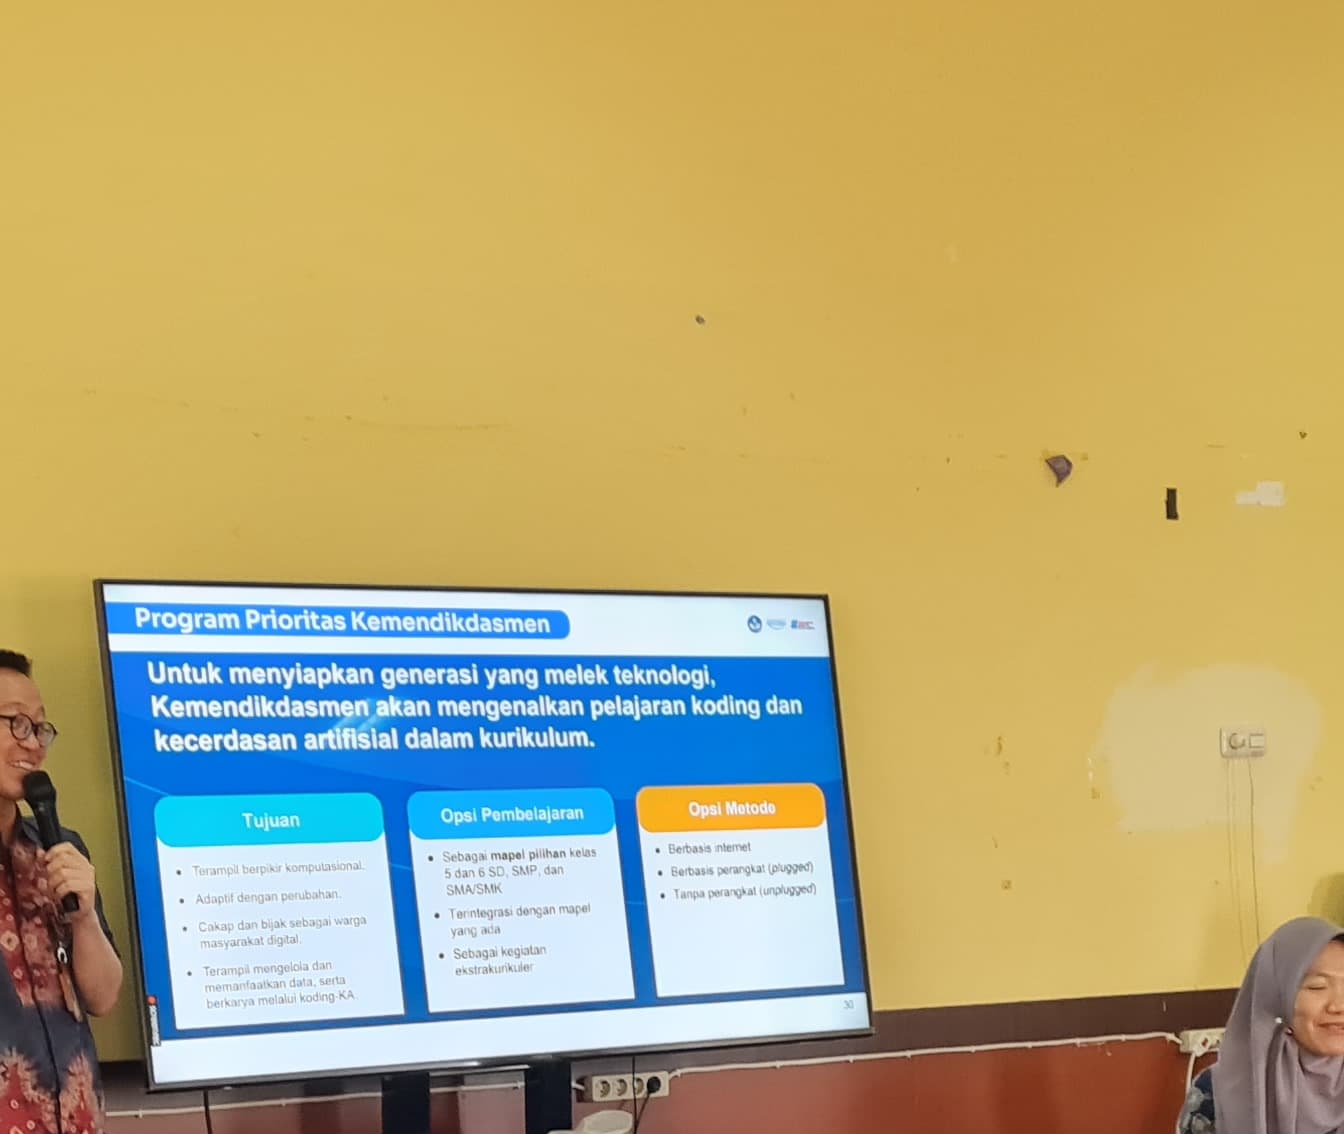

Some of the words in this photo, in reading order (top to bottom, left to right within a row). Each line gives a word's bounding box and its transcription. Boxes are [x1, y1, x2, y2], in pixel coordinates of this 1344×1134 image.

[135, 607, 239, 633] Program
[245, 609, 346, 631] Prioritas
[351, 610, 551, 633] Kemendikdasmen
[147, 661, 223, 685] Untuk
[229, 662, 374, 690] menyiapkan
[381, 663, 478, 690] generasi
[484, 666, 538, 690] yang
[545, 664, 608, 686] melek
[613, 664, 716, 690] teknologi,
[151, 695, 369, 718] Kemendikdasmen
[376, 695, 430, 717] akan
[437, 695, 584, 721] mengenalkan
[590, 695, 686, 721] pelajaran
[691, 695, 761, 719] koding
[766, 694, 803, 715] dan
[155, 728, 297, 752] kecerdasan
[304, 727, 399, 751] artifisial
[405, 726, 474, 750] dalam
[479, 727, 595, 748] kurikulum.
[440, 807, 477, 826] Opsi
[481, 805, 585, 824] Pembelajaran
[688, 801, 722, 819] Opsi
[725, 800, 777, 816] Metode
[241, 812, 301, 832] Tujuan
[442, 850, 489, 864] Sebagai
[490, 849, 526, 863] mapel
[528, 848, 567, 862] pilihan
[569, 847, 597, 859] kelas
[668, 843, 712, 855] Berbasis
[715, 842, 752, 853] internet
[192, 864, 240, 878] Terampil
[242, 863, 282, 877] berpikir
[444, 868, 452, 879] 5
[454, 867, 475, 879] dan
[478, 867, 486, 878] 6
[543, 863, 565, 876] dan
[671, 865, 714, 878] Berbasis
[717, 863, 765, 877] perangkat
[768, 861, 815, 876] (plugged)
[446, 882, 504, 897] SMA/SMK
[674, 888, 706, 901] Tanpa
[707, 885, 757, 900] perangkat
[759, 882, 817, 898] (unplugged)
[195, 892, 235, 906] Adaptif
[237, 891, 278, 906] dengan
[448, 906, 514, 921] Terintegrasi
[515, 904, 556, 919] dengan
[558, 902, 592, 917] mapel
[198, 920, 235, 934] Cakap
[237, 919, 258, 931] dan
[260, 916, 287, 931] bijak
[289, 915, 332, 930] sebagai
[333, 915, 367, 927] warga
[450, 926, 478, 940] yang
[480, 924, 502, 936] ada
[200, 934, 265, 950] masyarakat
[452, 945, 499, 961] Sebagai
[500, 944, 547, 960] kegiatan
[203, 963, 251, 978] Terampil
[253, 960, 310, 977] mengelola
[312, 960, 333, 972] dan
[454, 961, 534, 977] ekstrakurikuler
[319, 975, 346, 986] serta
[206, 994, 256, 1010] berkarya
[258, 993, 298, 1006] melalui
